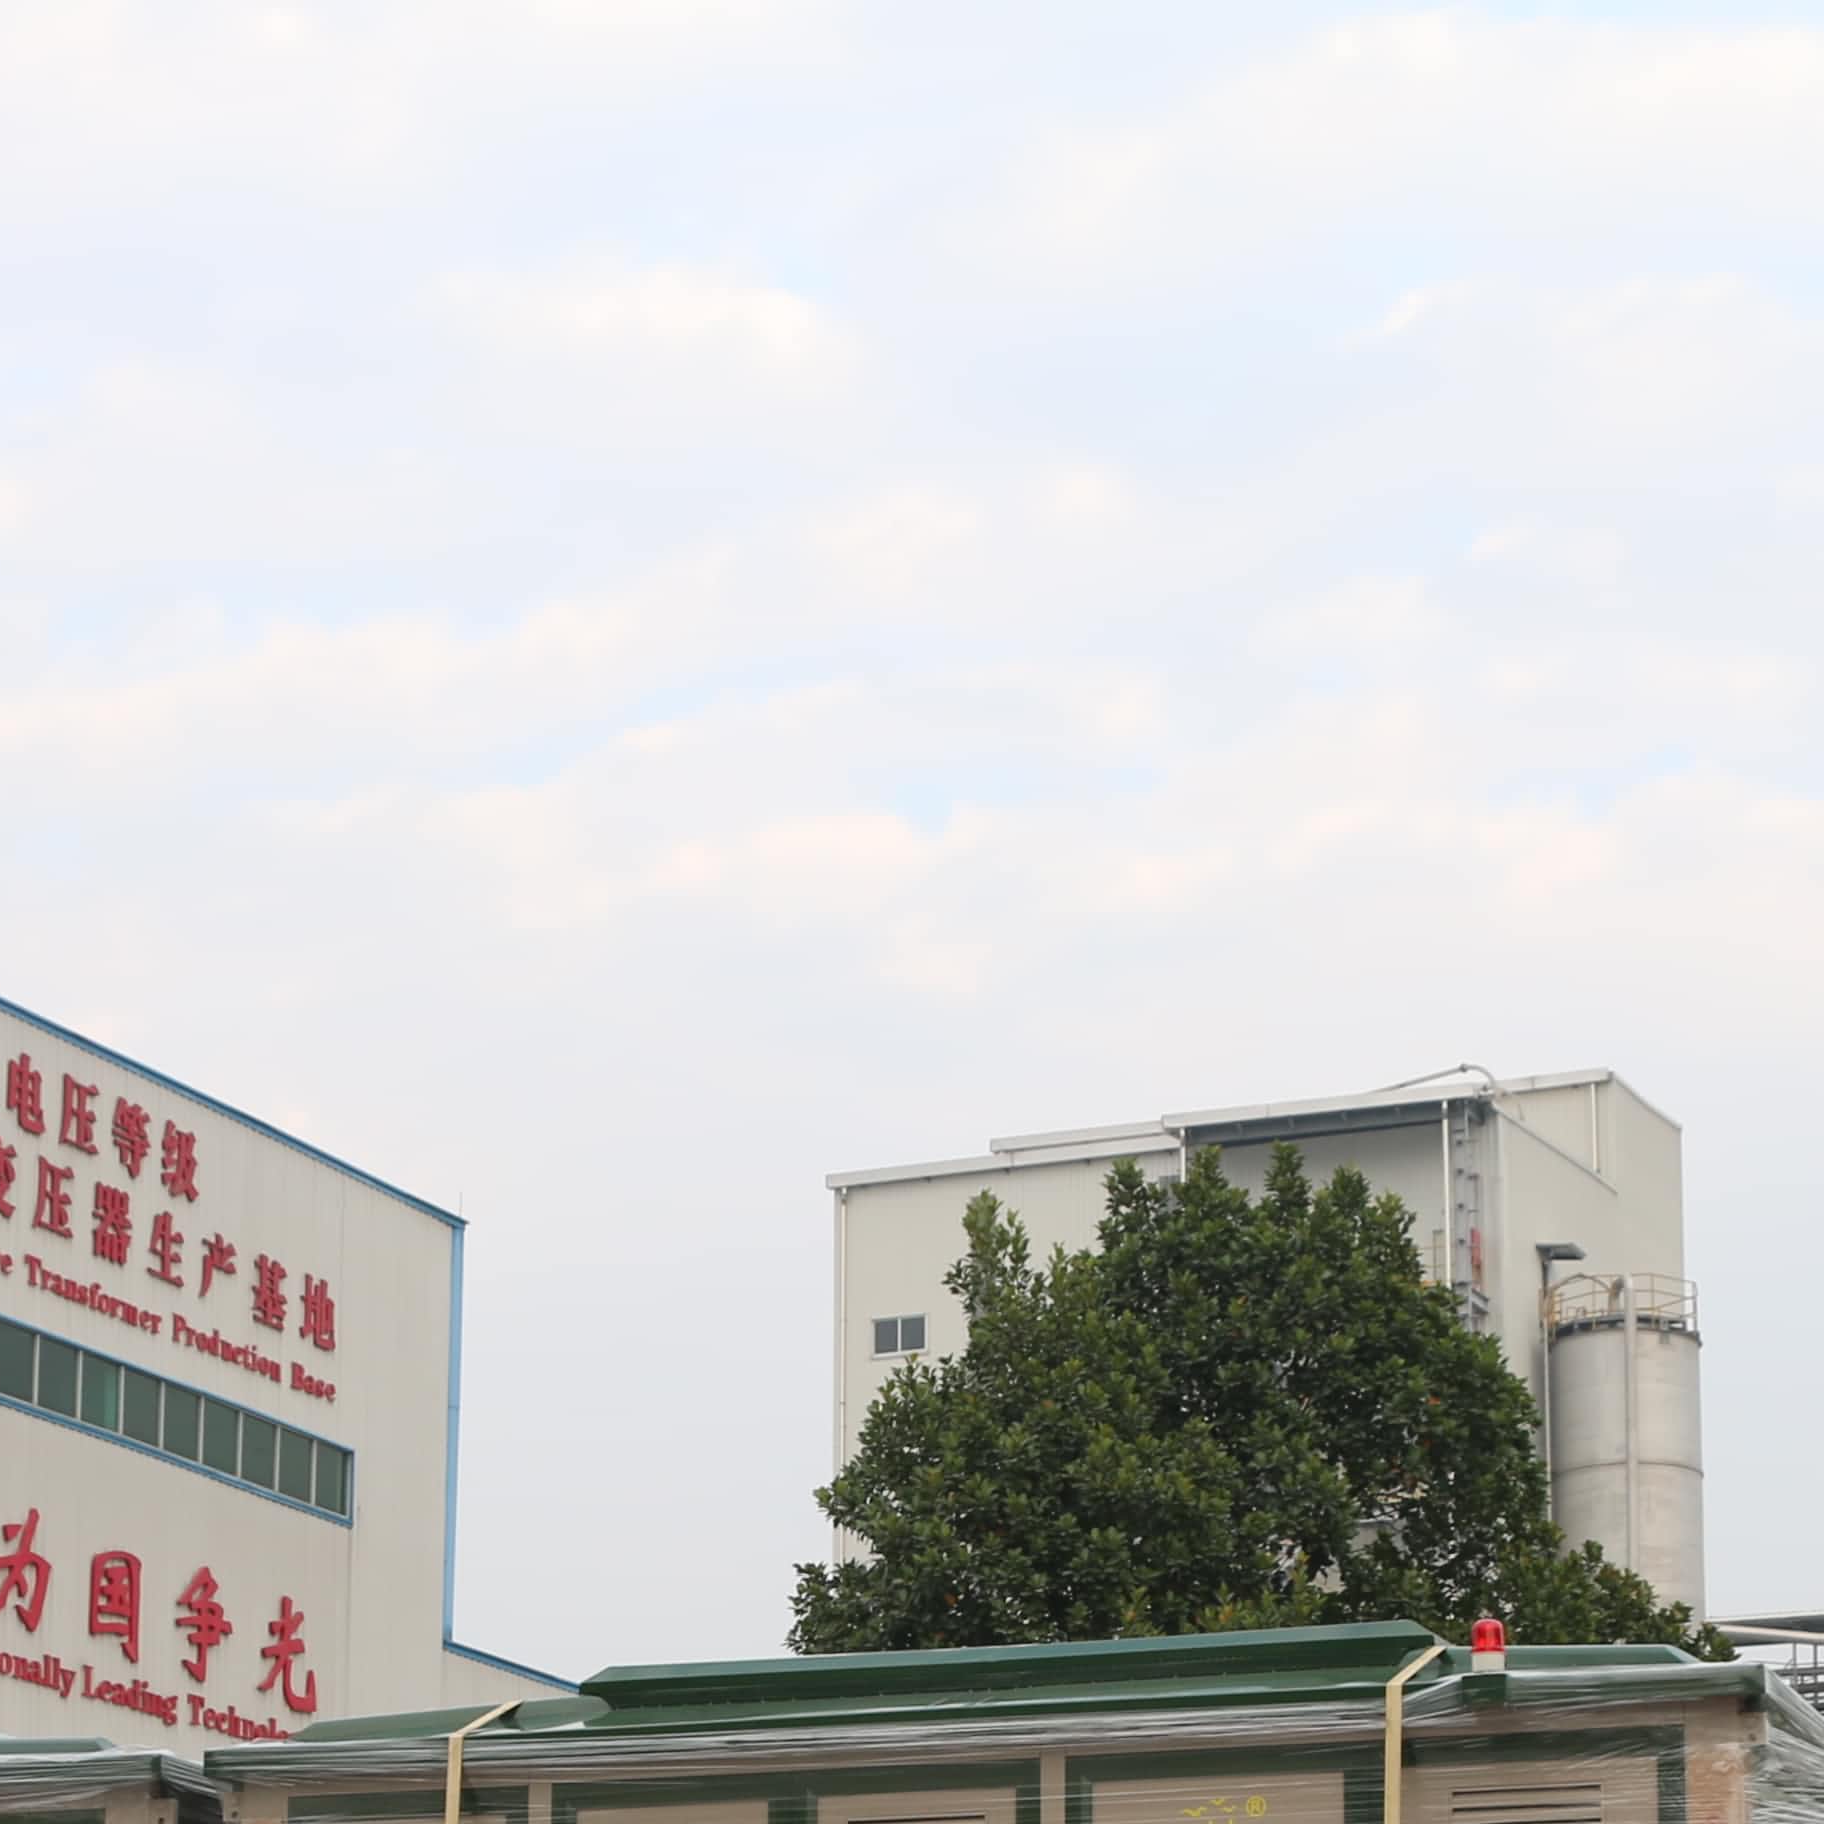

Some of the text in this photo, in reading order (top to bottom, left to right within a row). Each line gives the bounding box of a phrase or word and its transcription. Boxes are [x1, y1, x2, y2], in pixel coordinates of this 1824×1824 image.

[24, 1252, 163, 1335] Transformer
[171, 1312, 281, 1384] Production
[290, 1360, 337, 1402] Base
[82, 1665, 179, 1727] Leading
